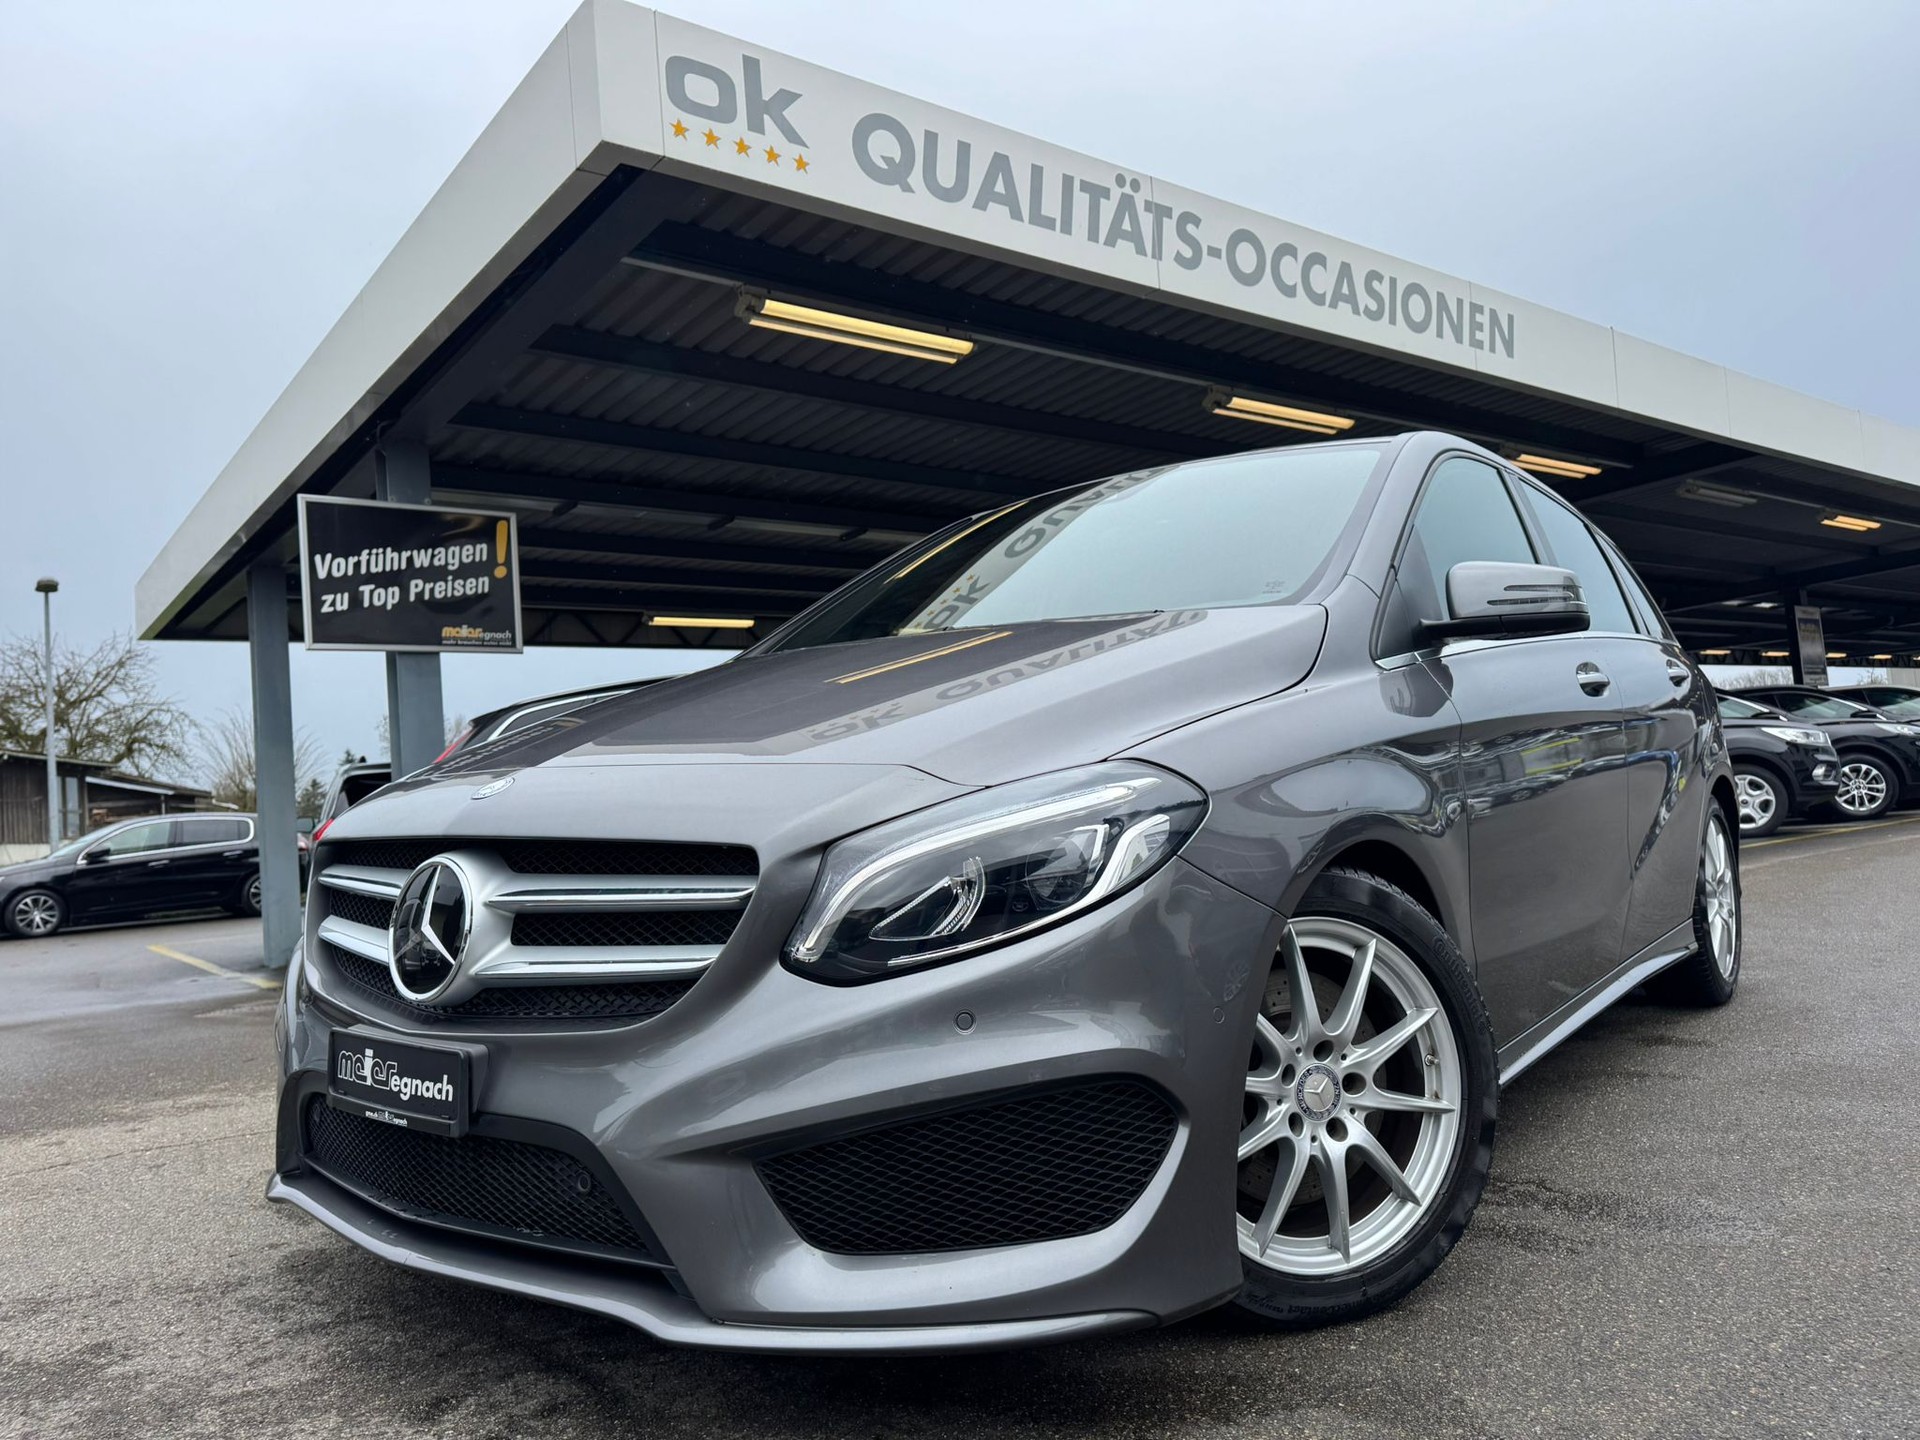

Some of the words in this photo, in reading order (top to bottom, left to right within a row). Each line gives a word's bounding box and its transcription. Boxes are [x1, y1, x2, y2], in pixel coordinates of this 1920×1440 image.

[665, 54, 810, 149] ok
[852, 113, 1514, 358] QUALITÄTS-OCCASIONEN
[314, 542, 487, 579] Vorführwagen
[320, 592, 348, 613] zu
[359, 584, 400, 610] Top
[409, 576, 489, 602] Preisen
